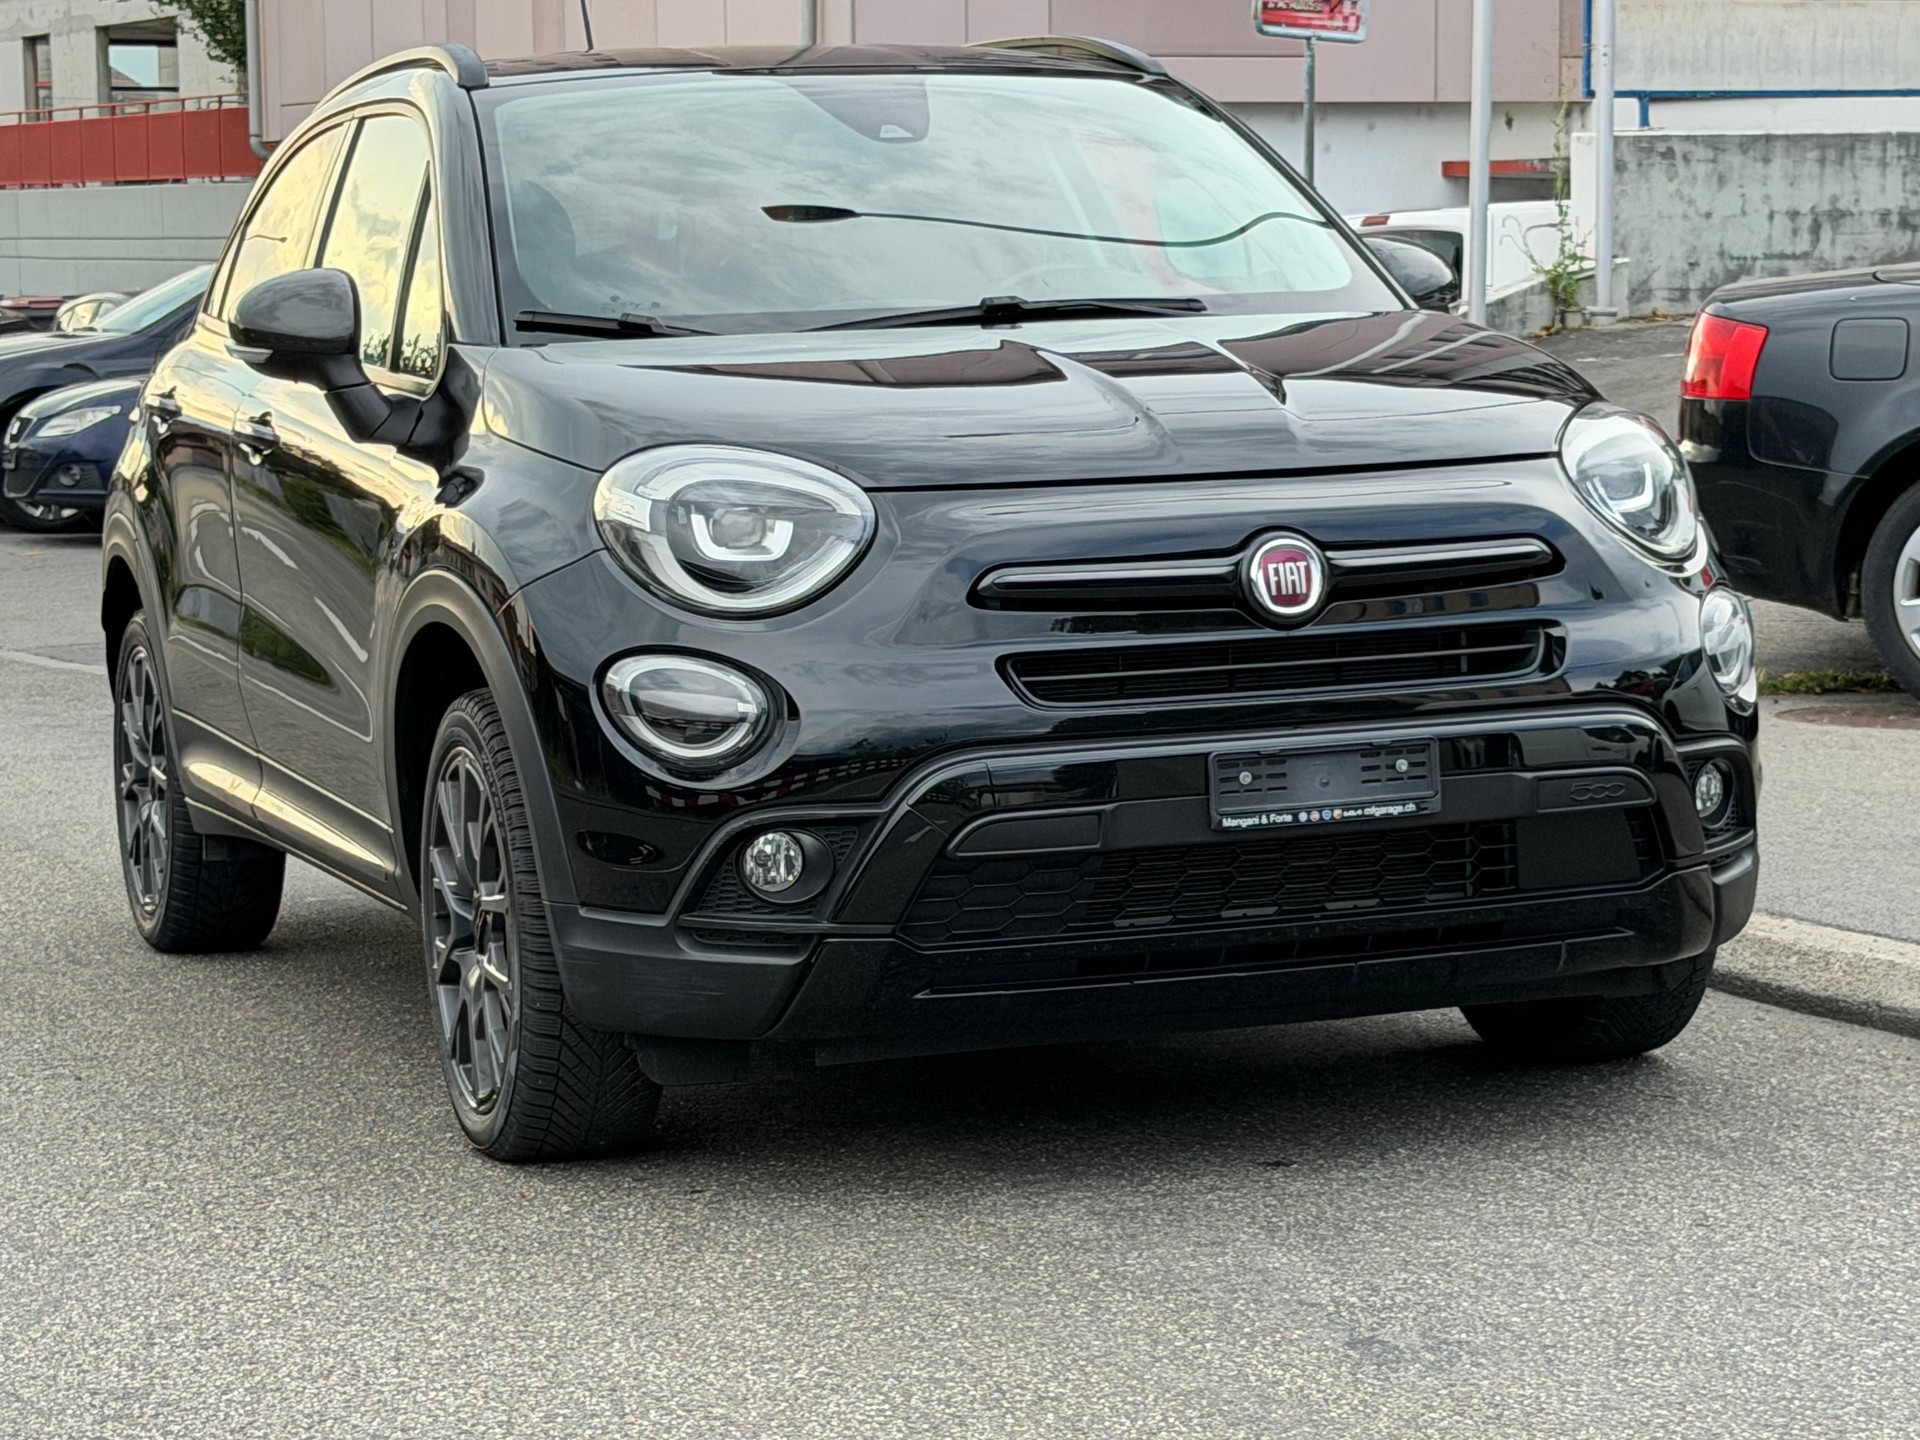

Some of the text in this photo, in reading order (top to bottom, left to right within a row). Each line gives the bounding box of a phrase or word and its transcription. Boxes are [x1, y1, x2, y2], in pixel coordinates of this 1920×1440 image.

[1267, 561, 1308, 596] FIAT
[1570, 782, 1626, 800] 500
[1261, 814, 1269, 824] &
